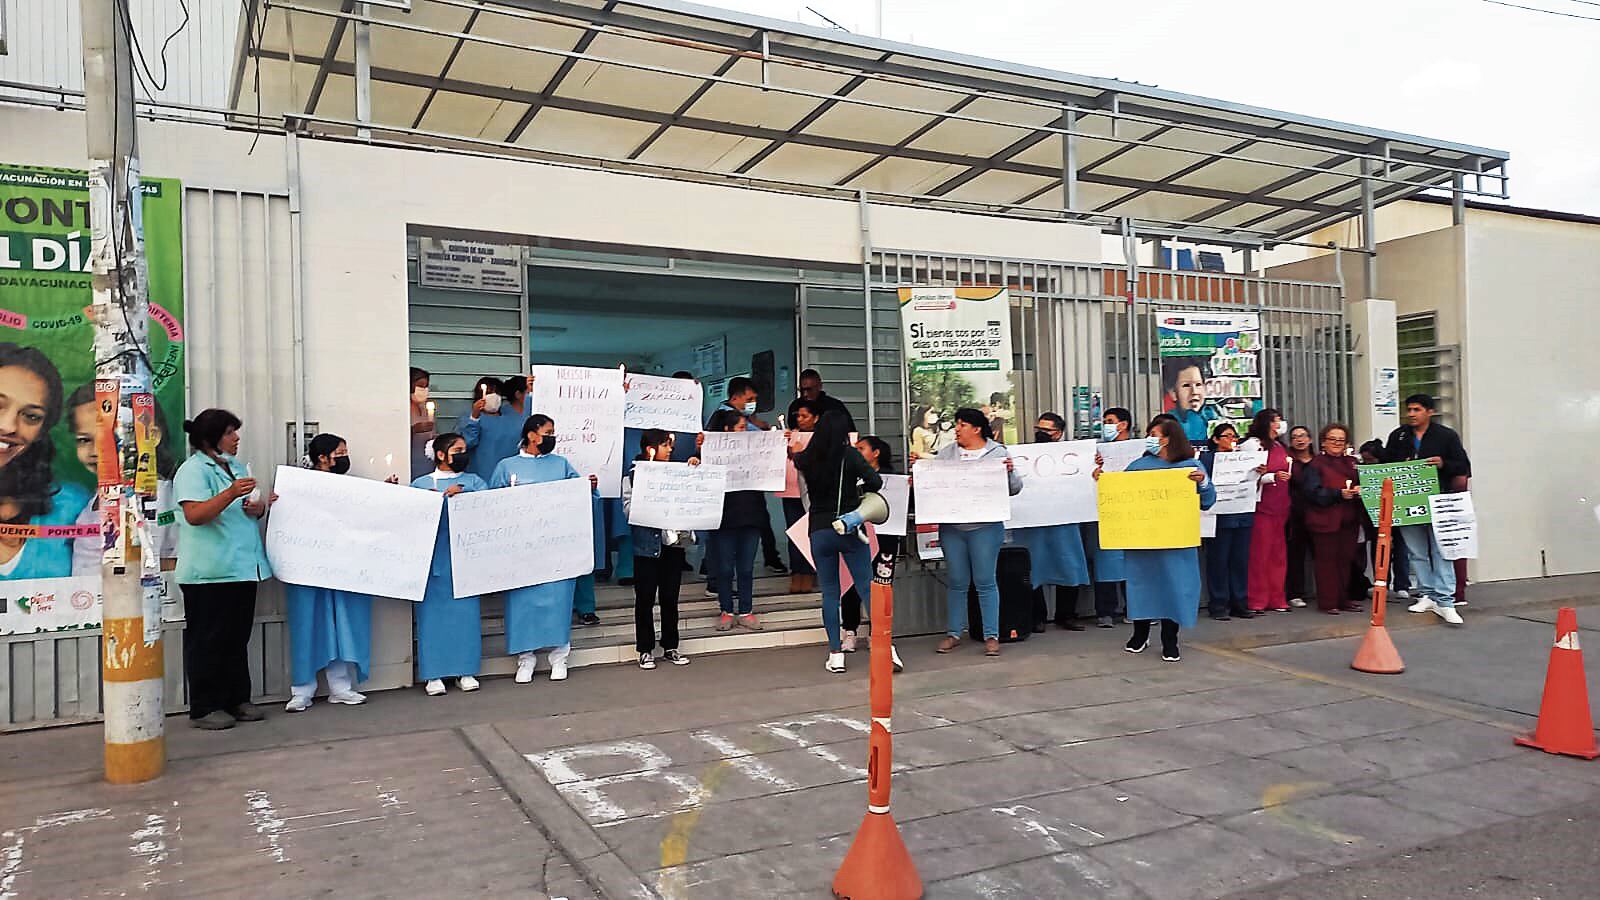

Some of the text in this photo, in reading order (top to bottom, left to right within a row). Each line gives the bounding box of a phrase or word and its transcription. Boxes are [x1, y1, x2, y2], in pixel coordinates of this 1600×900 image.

[68, 179, 83, 188] EN
[0, 196, 90, 229] ONT
[32, 314, 82, 329] COVID-19
[926, 330, 953, 338] tienes
[955, 329, 969, 338] tos
[971, 330, 985, 340] por
[961, 339, 986, 348] puede
[988, 339, 1001, 347] ser
[920, 348, 973, 359] tuberculosis
[0, 524, 100, 537] UENTA PONTE AL
